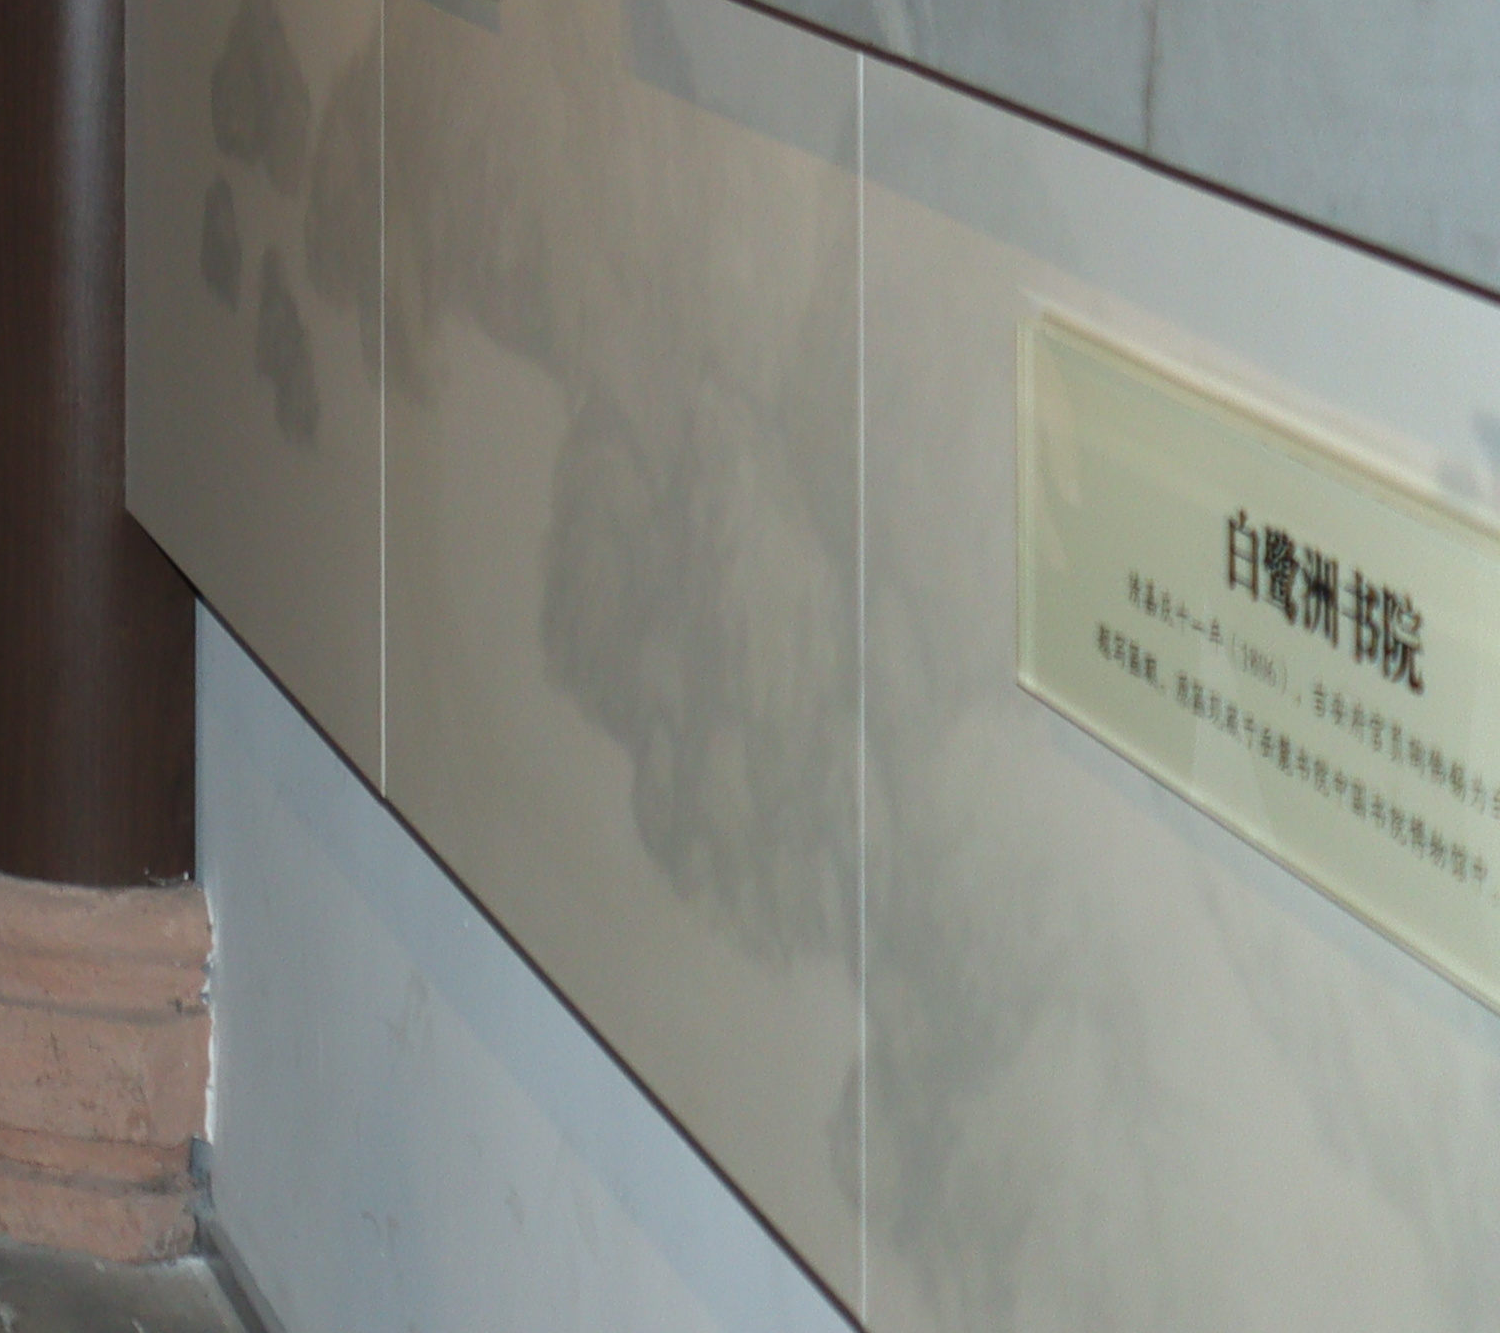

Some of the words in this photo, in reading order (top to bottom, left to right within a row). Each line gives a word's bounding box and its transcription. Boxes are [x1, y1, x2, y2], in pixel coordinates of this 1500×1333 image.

[1227, 508, 1424, 694] 白鹭洲书院
